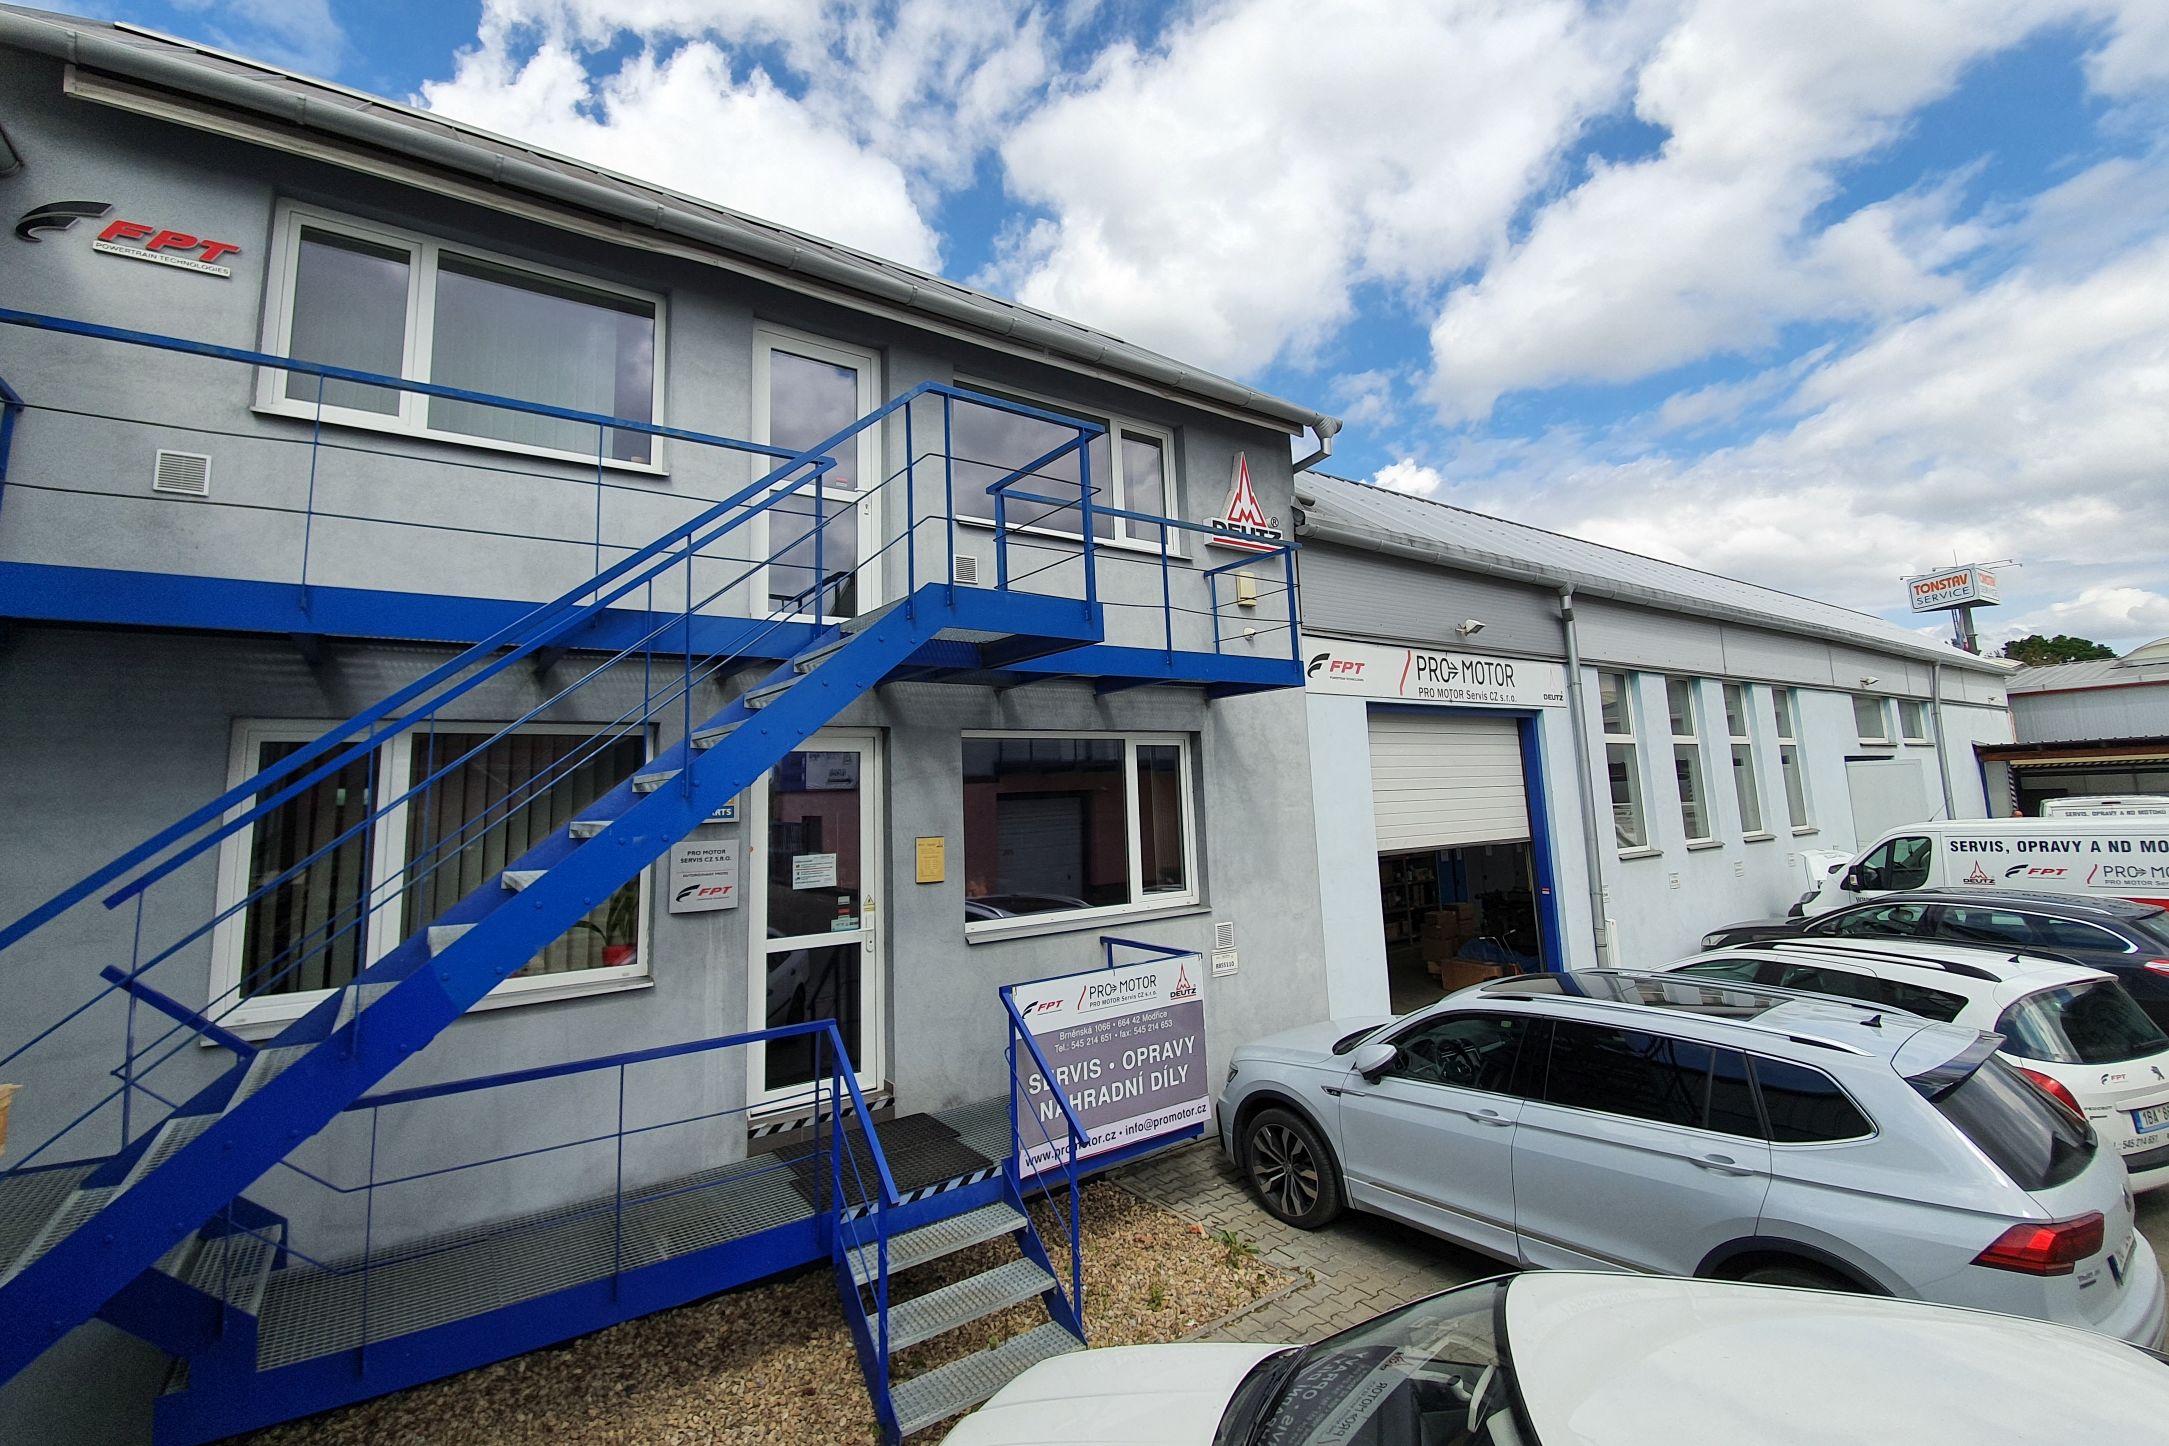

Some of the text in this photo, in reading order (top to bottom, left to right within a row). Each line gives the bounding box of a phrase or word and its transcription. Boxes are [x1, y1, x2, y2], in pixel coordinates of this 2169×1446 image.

[97, 219, 242, 263] FPT
[95, 241, 230, 276] POWERTRAIN TECHNOLOGIES
[1913, 573, 1968, 596] TONSTAV
[1916, 586, 1970, 606] SERVICE
[1329, 660, 1365, 675] FPT
[1462, 660, 1516, 688] MOTOR
[1418, 687, 1435, 698] PRO
[1437, 688, 1465, 700] MOTOR
[1466, 689, 1489, 701] Servis
[1489, 691, 1499, 702] CZ
[1543, 693, 1565, 702] DEUTZ
[1950, 839, 2010, 855] SERVIS,
[2017, 840, 2082, 854] OPRAVY
[2090, 840, 2102, 853] A
[2108, 840, 2132, 853] ND
[2028, 868, 2069, 876] FPT
[698, 886, 733, 896] FPT
[1119, 974, 1157, 994] MOTOR
[1169, 987, 1197, 998] DEUTZ
[1037, 998, 1064, 1012] FPT
[1089, 1000, 1101, 1008] PRO
[1101, 996, 1121, 1006] MOTOR
[1121, 992, 1137, 1002] Servis
[1137, 991, 1145, 999] CZ
[1059, 1026, 1093, 1041] Brněnská
[1094, 1021, 1111, 1032] 1066
[1117, 1017, 1131, 1027] 664
[1132, 1014, 1141, 1024] 42
[1071, 1039, 1085, 1050] 545
[1086, 1036, 1099, 1047] 214
[1100, 1033, 1113, 1044] 651
[1133, 1026, 1146, 1037] 545
[1147, 1022, 1159, 1032] 214
[1160, 1019, 1173, 1029] 653
[1122, 1035, 1196, 1070] OPRAVY
[1151, 1063, 1189, 1092] DÍLY
[1125, 1104, 1207, 1135] info@promotor.cz
